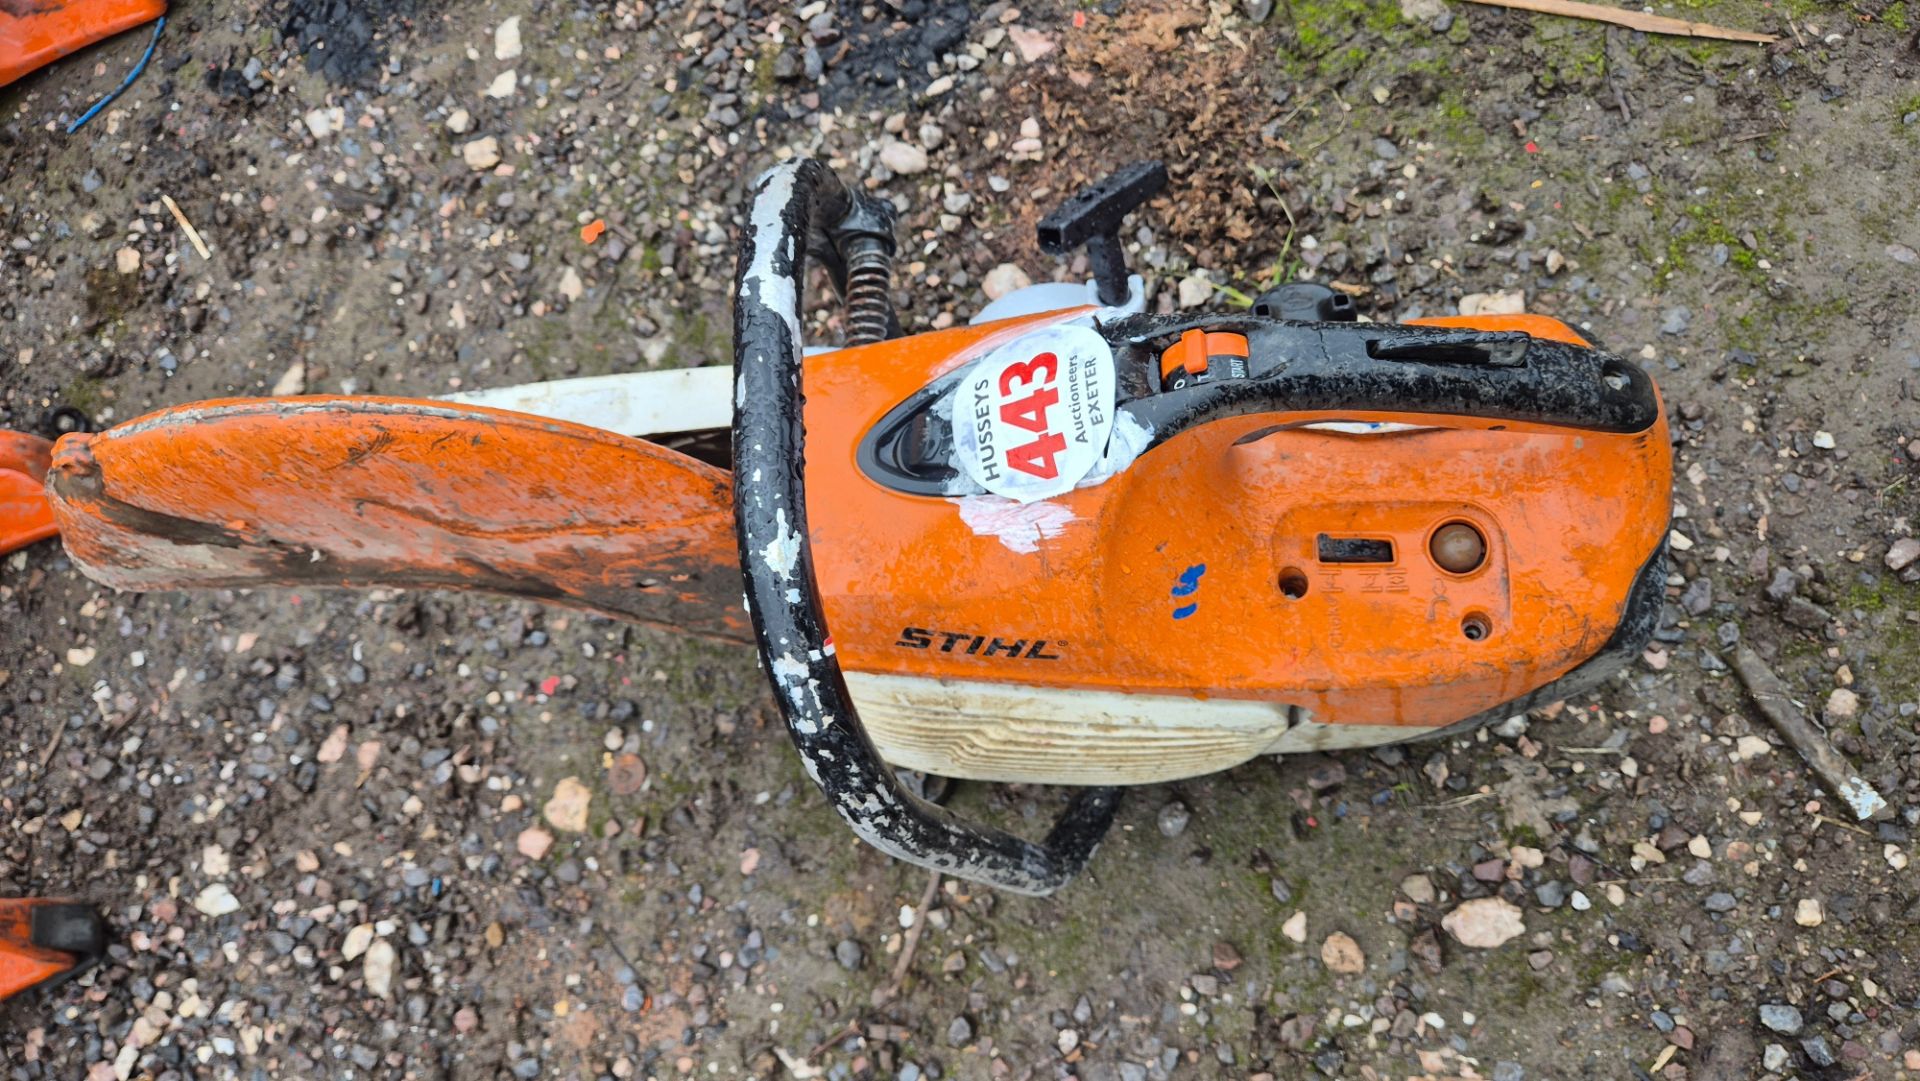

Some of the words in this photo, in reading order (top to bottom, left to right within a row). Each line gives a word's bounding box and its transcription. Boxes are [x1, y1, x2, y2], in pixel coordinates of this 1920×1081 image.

[1068, 354, 1088, 443] Auctioneers
[1084, 356, 1104, 426] EXETER
[1230, 357, 1245, 379] START
[974, 378, 1000, 482] HUSSEYS
[998, 351, 1067, 480] 443
